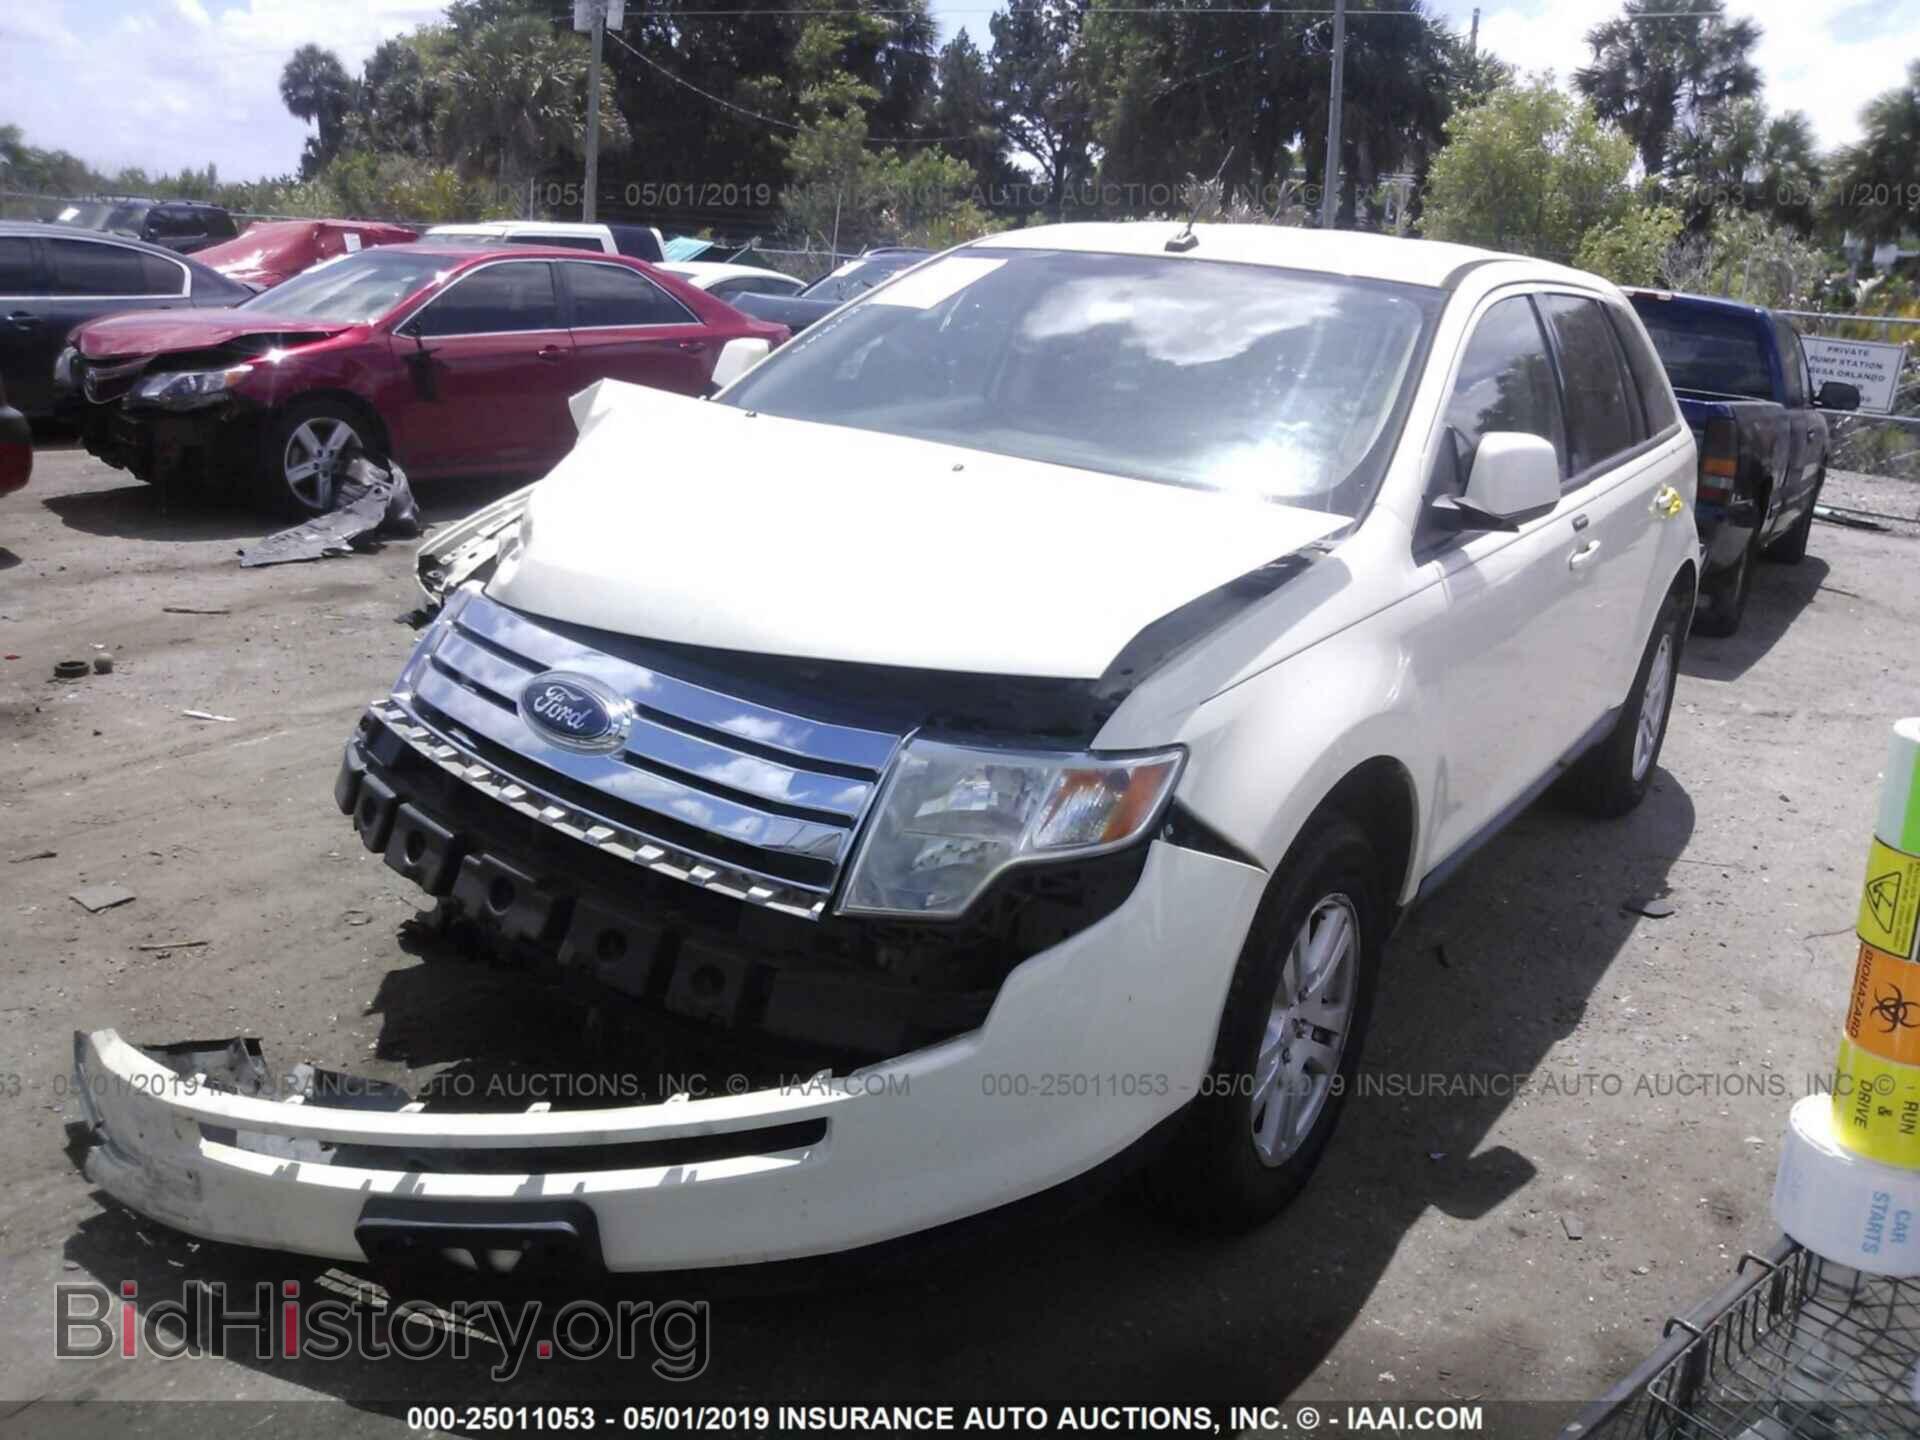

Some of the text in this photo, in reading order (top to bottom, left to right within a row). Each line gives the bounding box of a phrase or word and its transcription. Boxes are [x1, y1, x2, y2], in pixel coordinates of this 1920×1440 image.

[1810, 355, 1883, 369] PUMP STATION
[1827, 346, 1869, 357] PRIVATE
[1836, 370, 1886, 382] ORLANDO
[533, 685, 593, 729] Ford
[1851, 949, 1874, 1038] BIOHAZARD
[1854, 1079, 1873, 1128] DRIVE
[1899, 1100, 1919, 1135] RUN
[1861, 1191, 1890, 1254] STARTS
[1890, 1208, 1912, 1243] CAR
